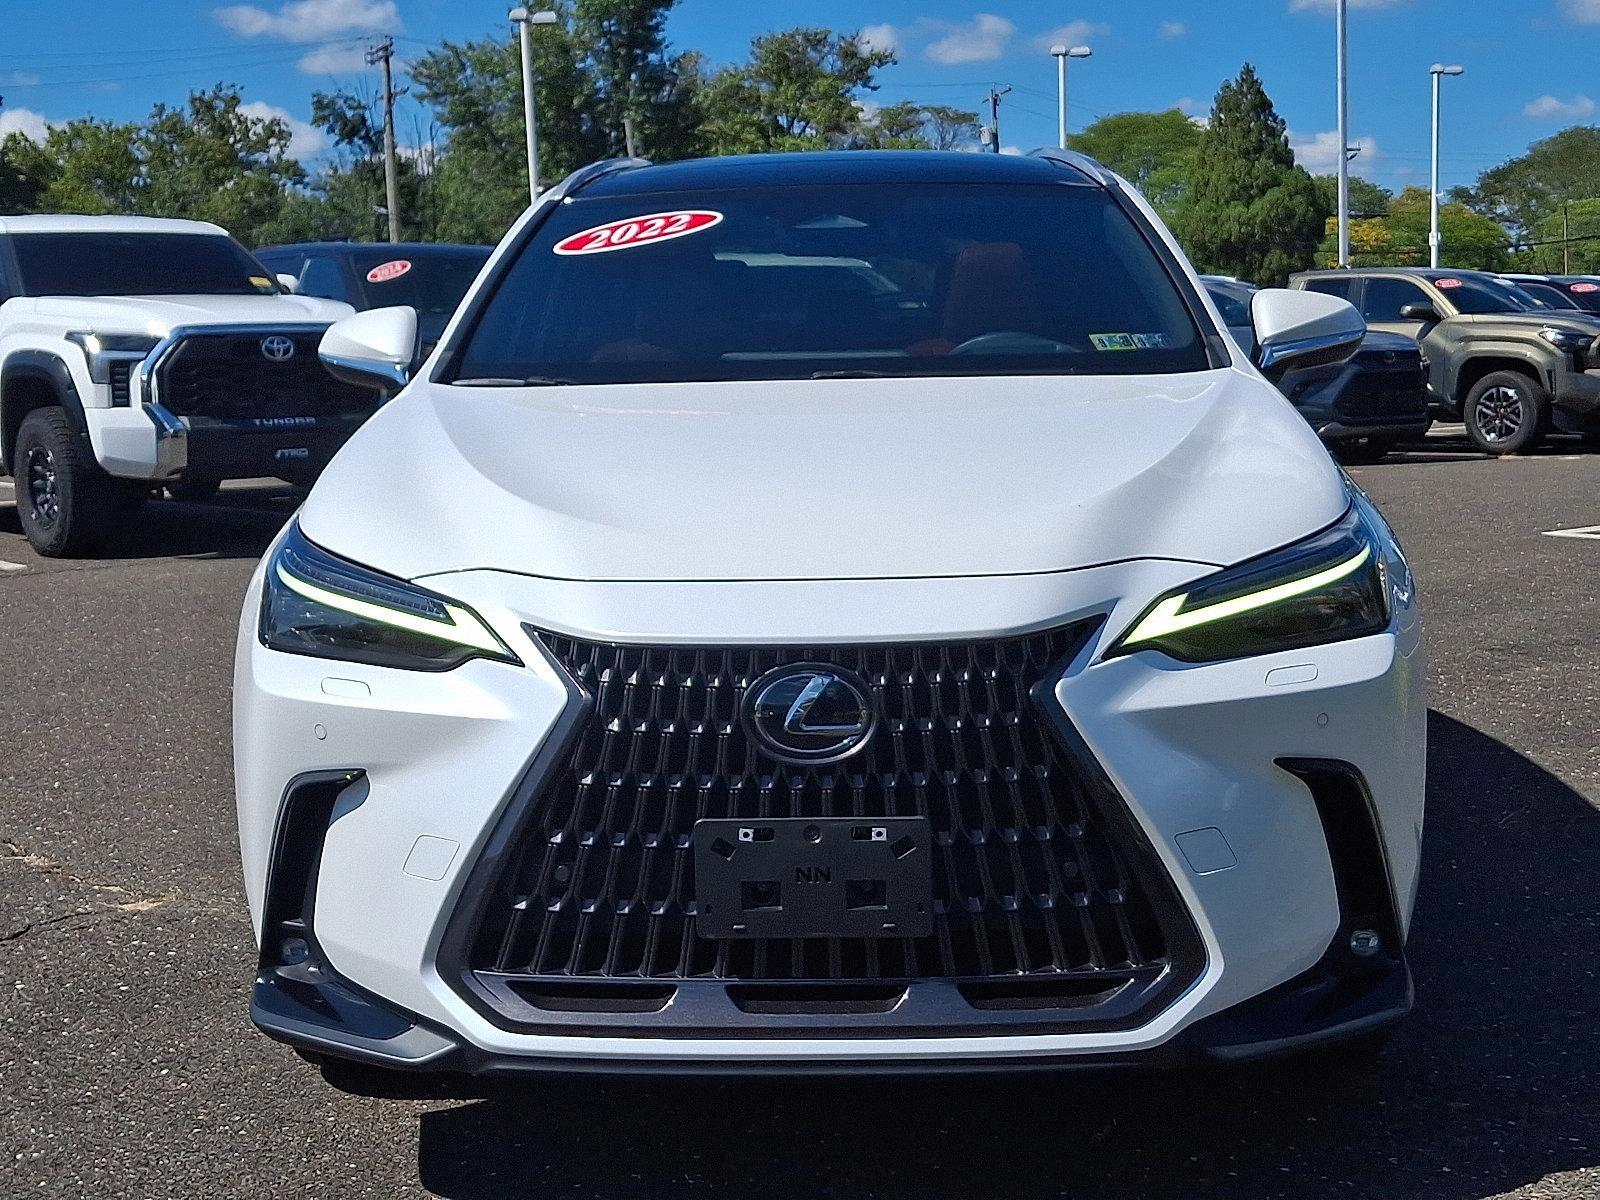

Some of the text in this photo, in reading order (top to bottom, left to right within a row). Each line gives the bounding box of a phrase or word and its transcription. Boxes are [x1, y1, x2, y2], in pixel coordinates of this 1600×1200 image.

[581, 213, 692, 251] 2022
[252, 416, 316, 427] TUNDRA
[794, 865, 832, 884] NN
